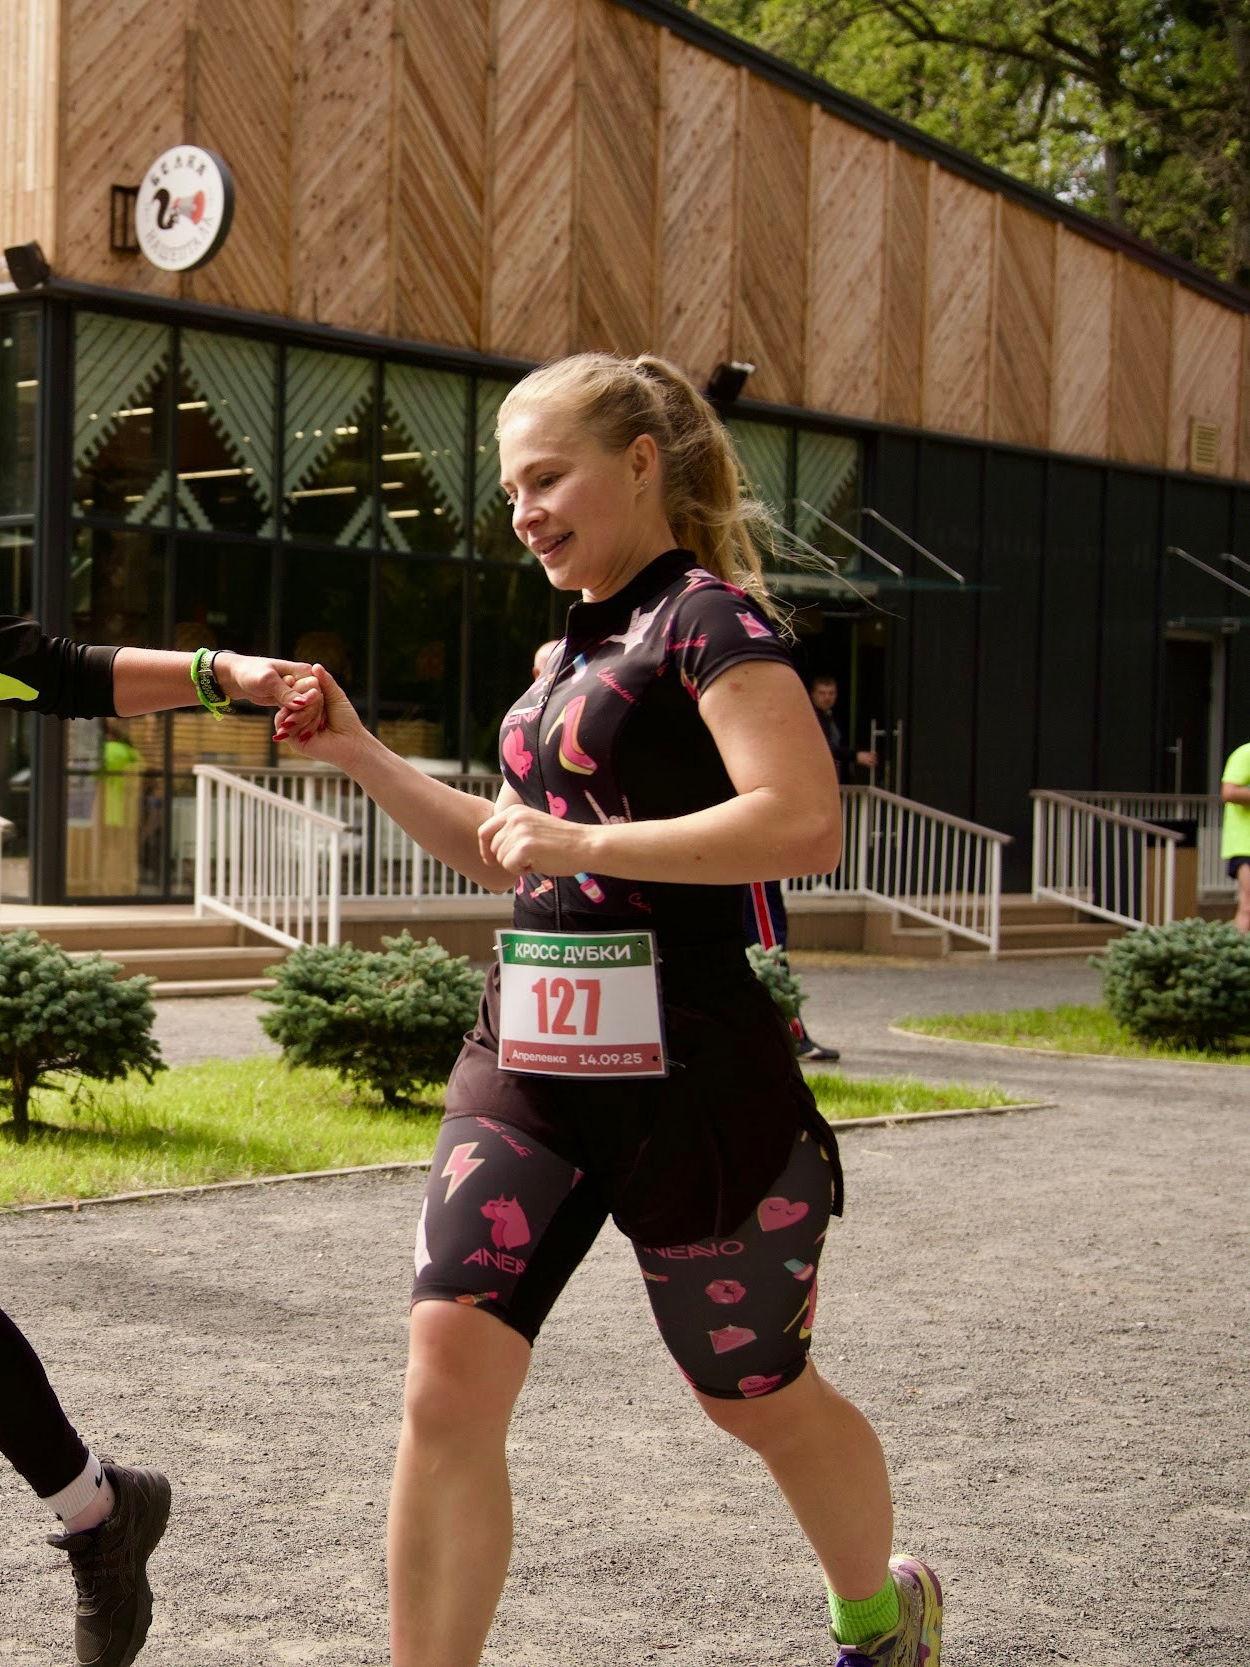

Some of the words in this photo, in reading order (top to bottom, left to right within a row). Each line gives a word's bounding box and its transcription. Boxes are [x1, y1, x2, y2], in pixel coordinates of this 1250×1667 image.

[514, 942, 560, 960] КРОСС
[562, 944, 631, 964] ДУБКИ
[531, 977, 601, 1036] 127
[511, 1049, 567, 1064] Апрелевка
[578, 1052, 643, 1066] 14.09.25
[643, 1240, 744, 1259] NEAVO
